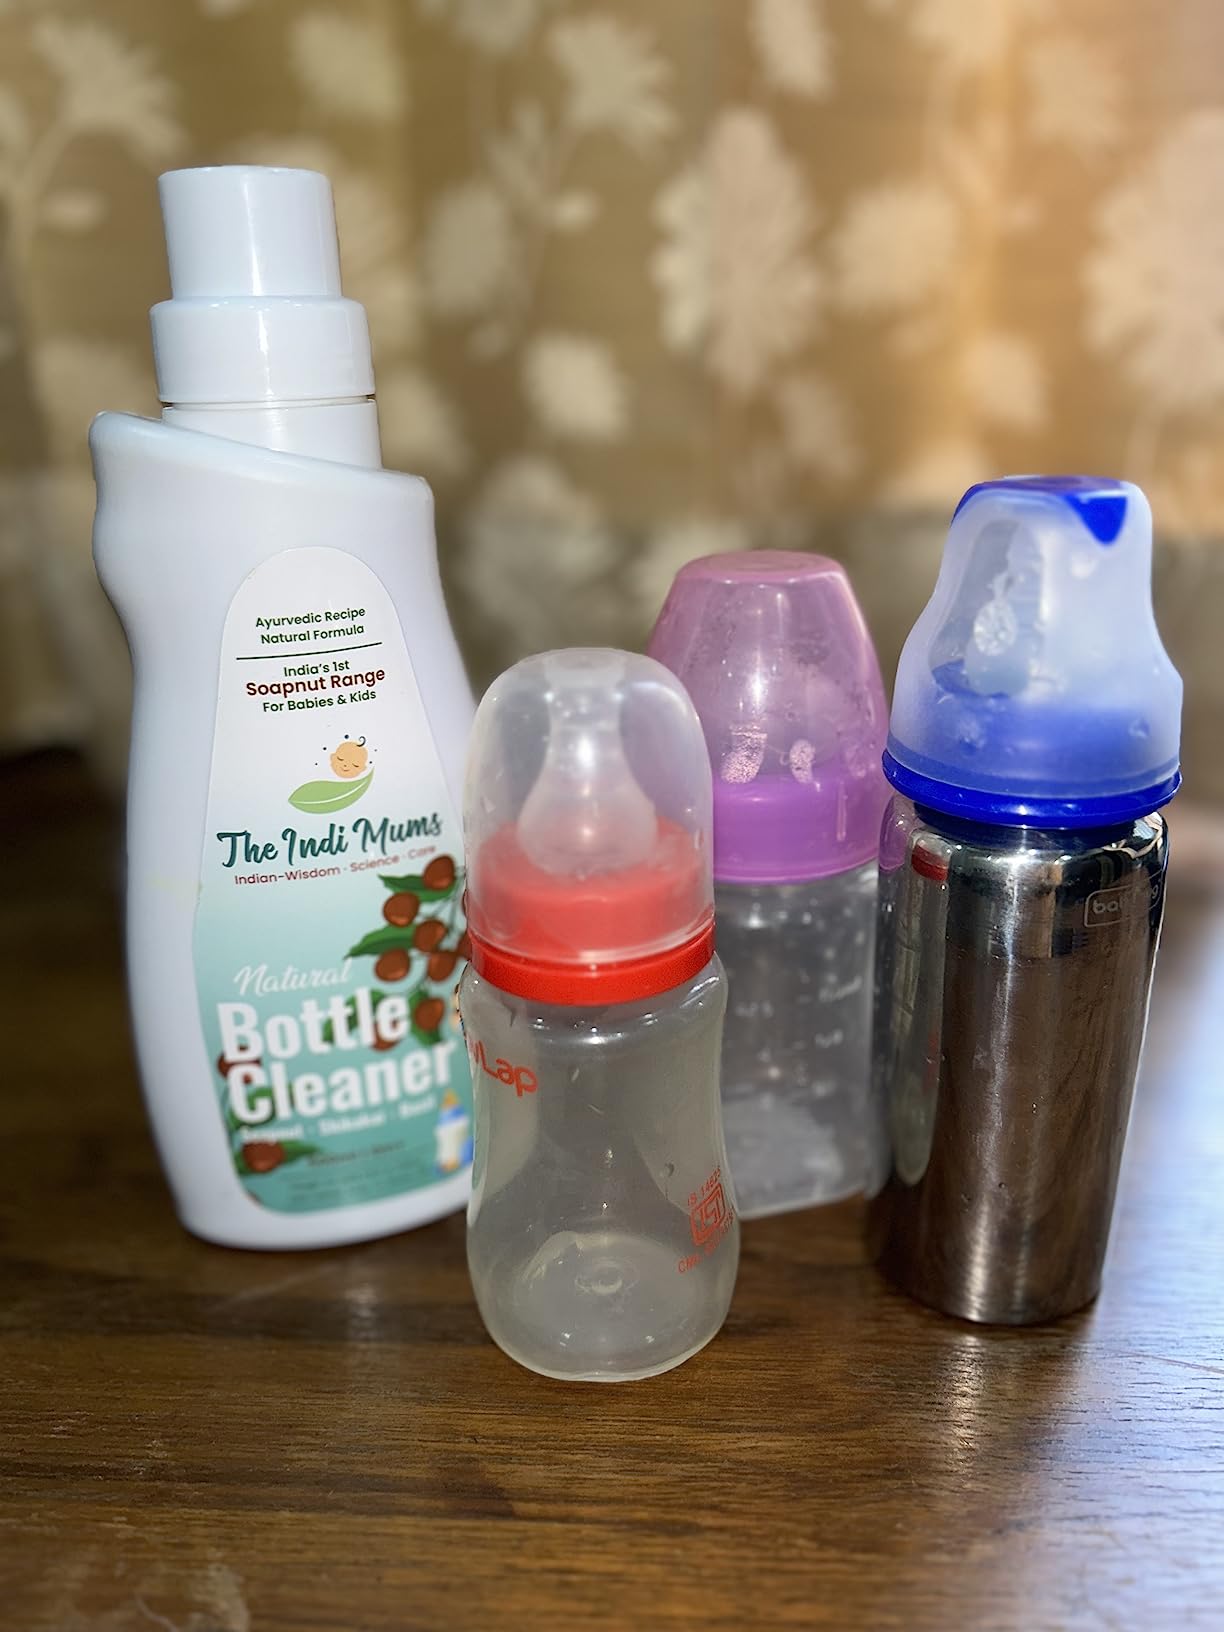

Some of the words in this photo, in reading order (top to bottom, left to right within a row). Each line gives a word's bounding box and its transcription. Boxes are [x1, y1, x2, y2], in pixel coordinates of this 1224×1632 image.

[255, 613, 322, 629] Ayurvedic
[325, 607, 366, 622] Recipe
[261, 631, 310, 644] Natural
[314, 624, 364, 640] Formula
[333, 661, 350, 673] 1st
[246, 677, 327, 698] Soapnut
[331, 668, 386, 689] Range
[263, 701, 285, 713] For
[288, 696, 334, 711] Babies
[337, 694, 347, 705] &
[350, 690, 377, 703] Kids
[216, 830, 278, 868] The
[281, 823, 349, 866] Indi
[352, 812, 443, 855] Mums
[235, 866, 340, 885] Indian-Wisdom
[234, 958, 353, 996] Natural
[217, 987, 411, 1064] Bottle
[227, 1040, 457, 1124] Cleaner
